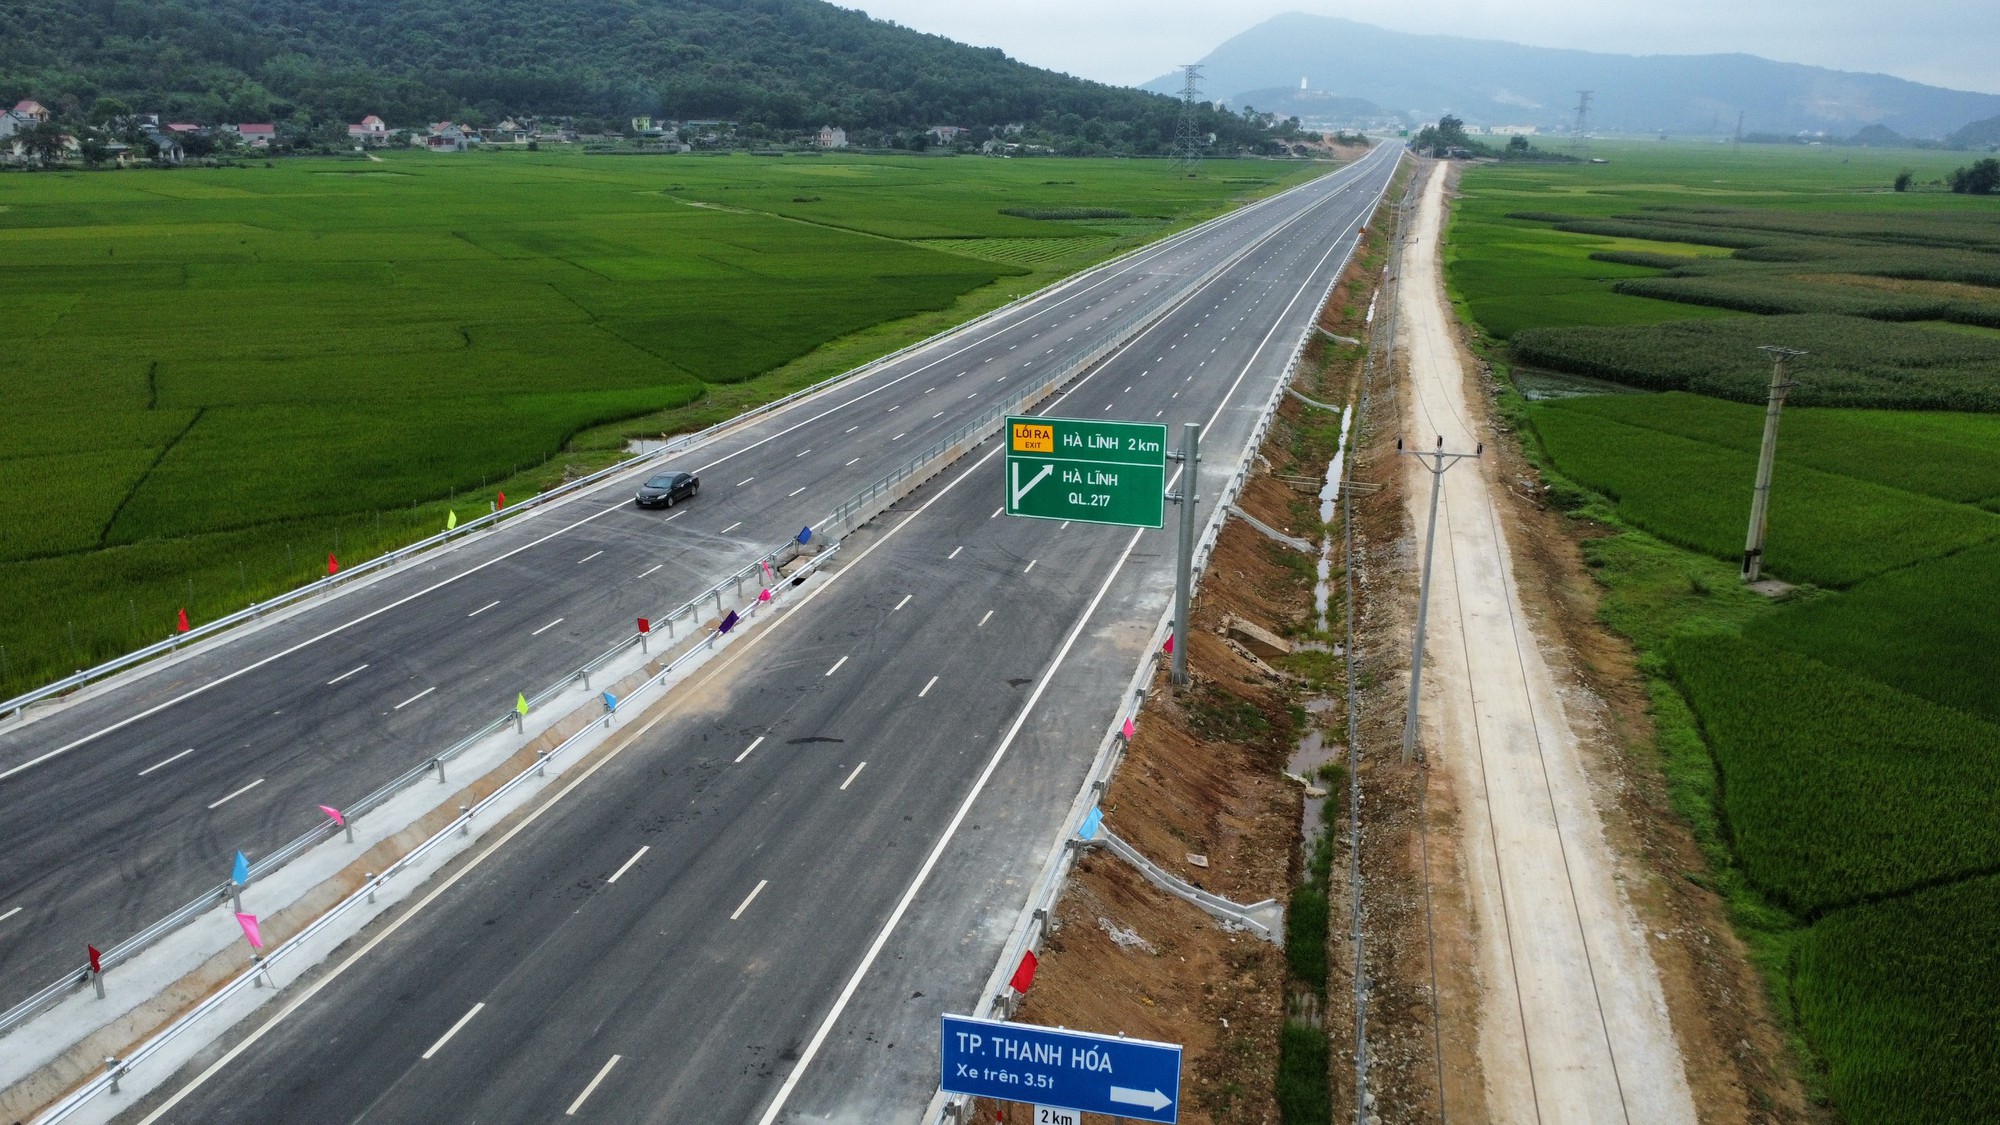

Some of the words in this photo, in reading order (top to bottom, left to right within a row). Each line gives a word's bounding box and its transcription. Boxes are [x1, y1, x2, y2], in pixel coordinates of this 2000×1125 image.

[1016, 424, 1032, 438] LỐI
[1034, 430, 1050, 439] RA
[1063, 432, 1083, 447] HÀ
[1088, 434, 1119, 450] LĨNH
[1128, 438, 1136, 451] 2
[1138, 439, 1159, 452] km
[1063, 468, 1082, 484] HÀ
[1087, 470, 1118, 486] LĨNH
[1068, 492, 1111, 507] QL.217
[956, 1032, 985, 1056] TP.
[992, 1036, 1062, 1067] THANH
[1071, 1044, 1113, 1074] HÓA
[956, 1063, 978, 1079] Xe
[983, 1067, 1019, 1084] trên
[1024, 1073, 1055, 1089] 3.5t
[1041, 1109, 1049, 1124] 2
[1052, 1111, 1072, 1125] km
